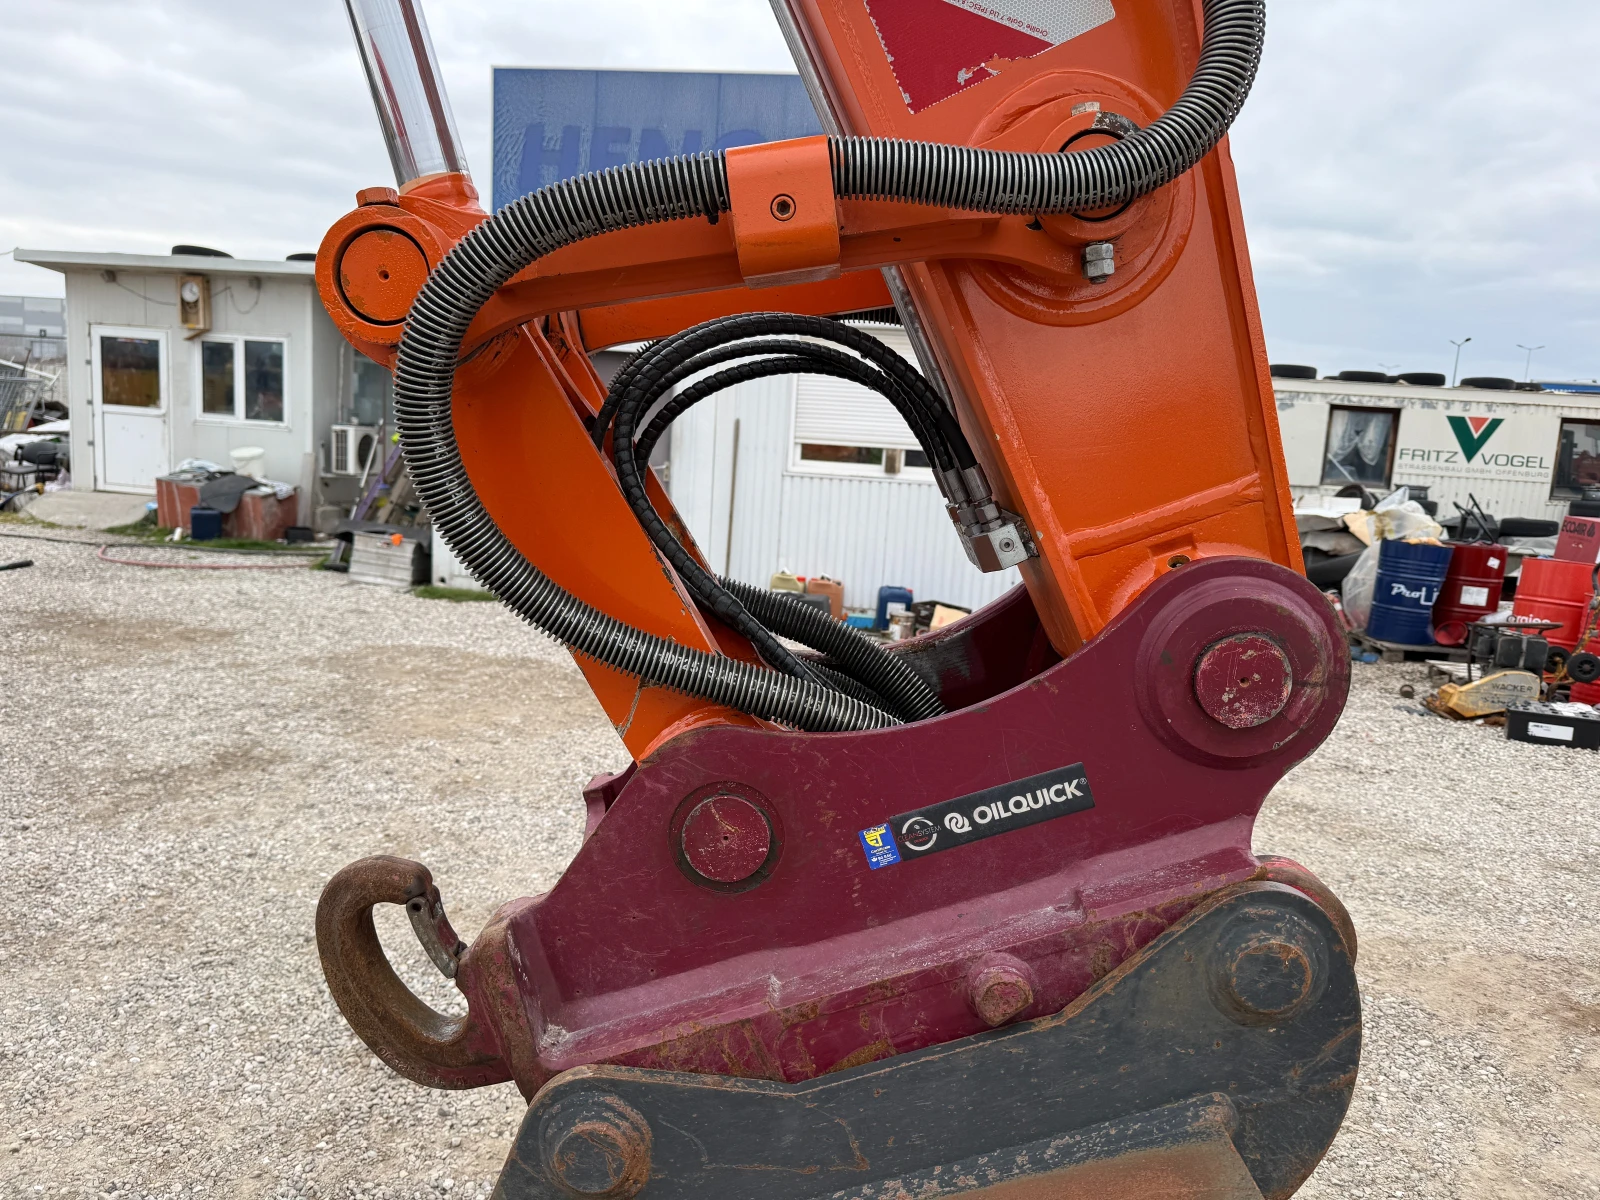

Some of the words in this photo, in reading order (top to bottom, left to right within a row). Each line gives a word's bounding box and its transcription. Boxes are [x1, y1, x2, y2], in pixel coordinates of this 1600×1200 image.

[989, 9, 1000, 18] Ltd
[1006, 16, 1024, 28] Gate
[1026, 23, 1048, 37] Oralite
[1398, 447, 1459, 464] FRITZ
[1481, 452, 1550, 470] VOGEL
[1495, 469, 1550, 478] OFFENBURG
[1491, 682, 1534, 694] WACKER
